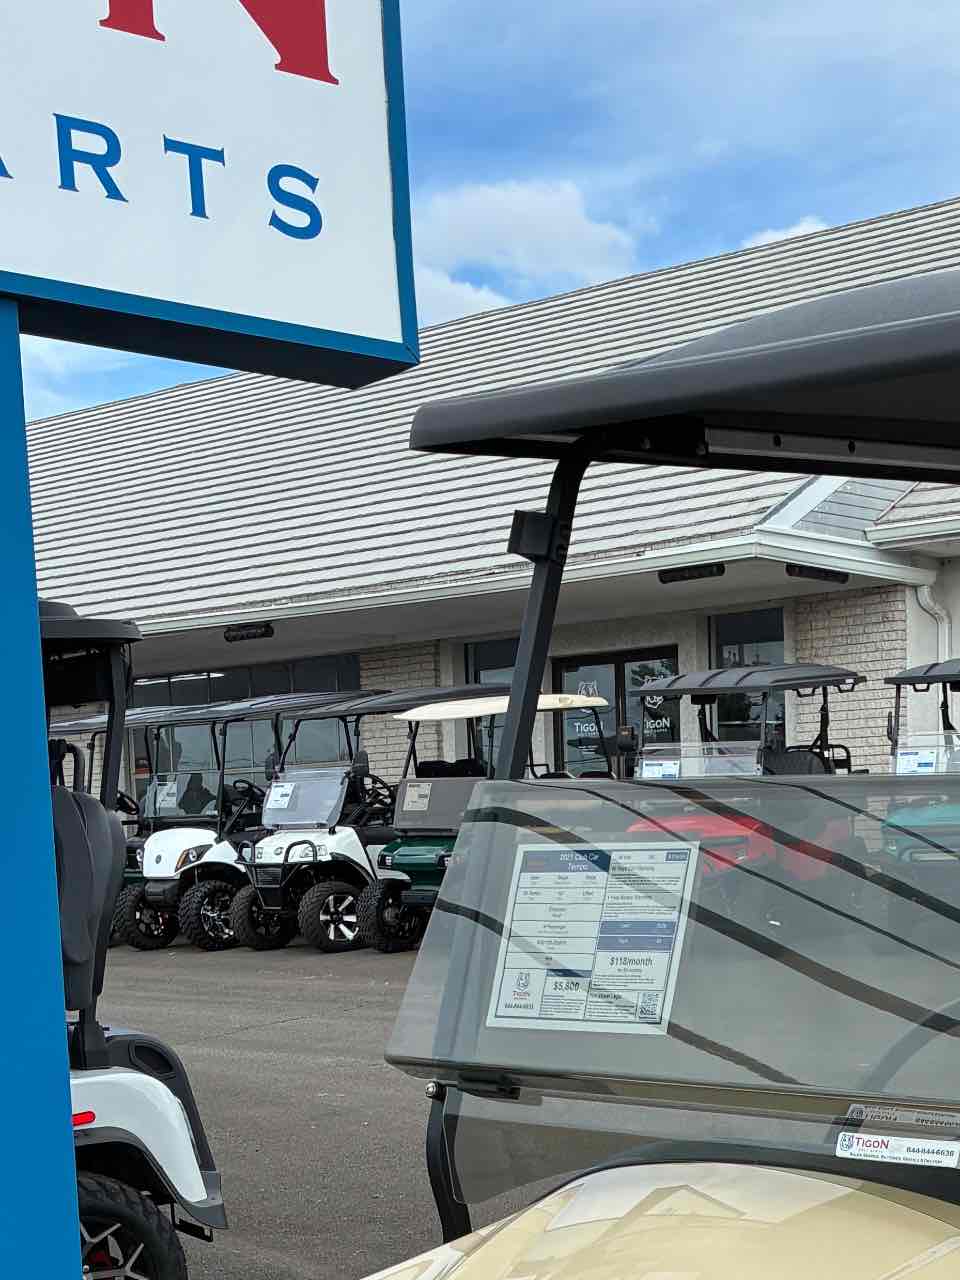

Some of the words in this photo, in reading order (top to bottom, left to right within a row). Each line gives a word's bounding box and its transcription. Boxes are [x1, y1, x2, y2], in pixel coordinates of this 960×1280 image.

[0, 113, 323, 240] RTS
[644, 717, 671, 729] IGON
[855, 1137, 890, 1149] TIGON
